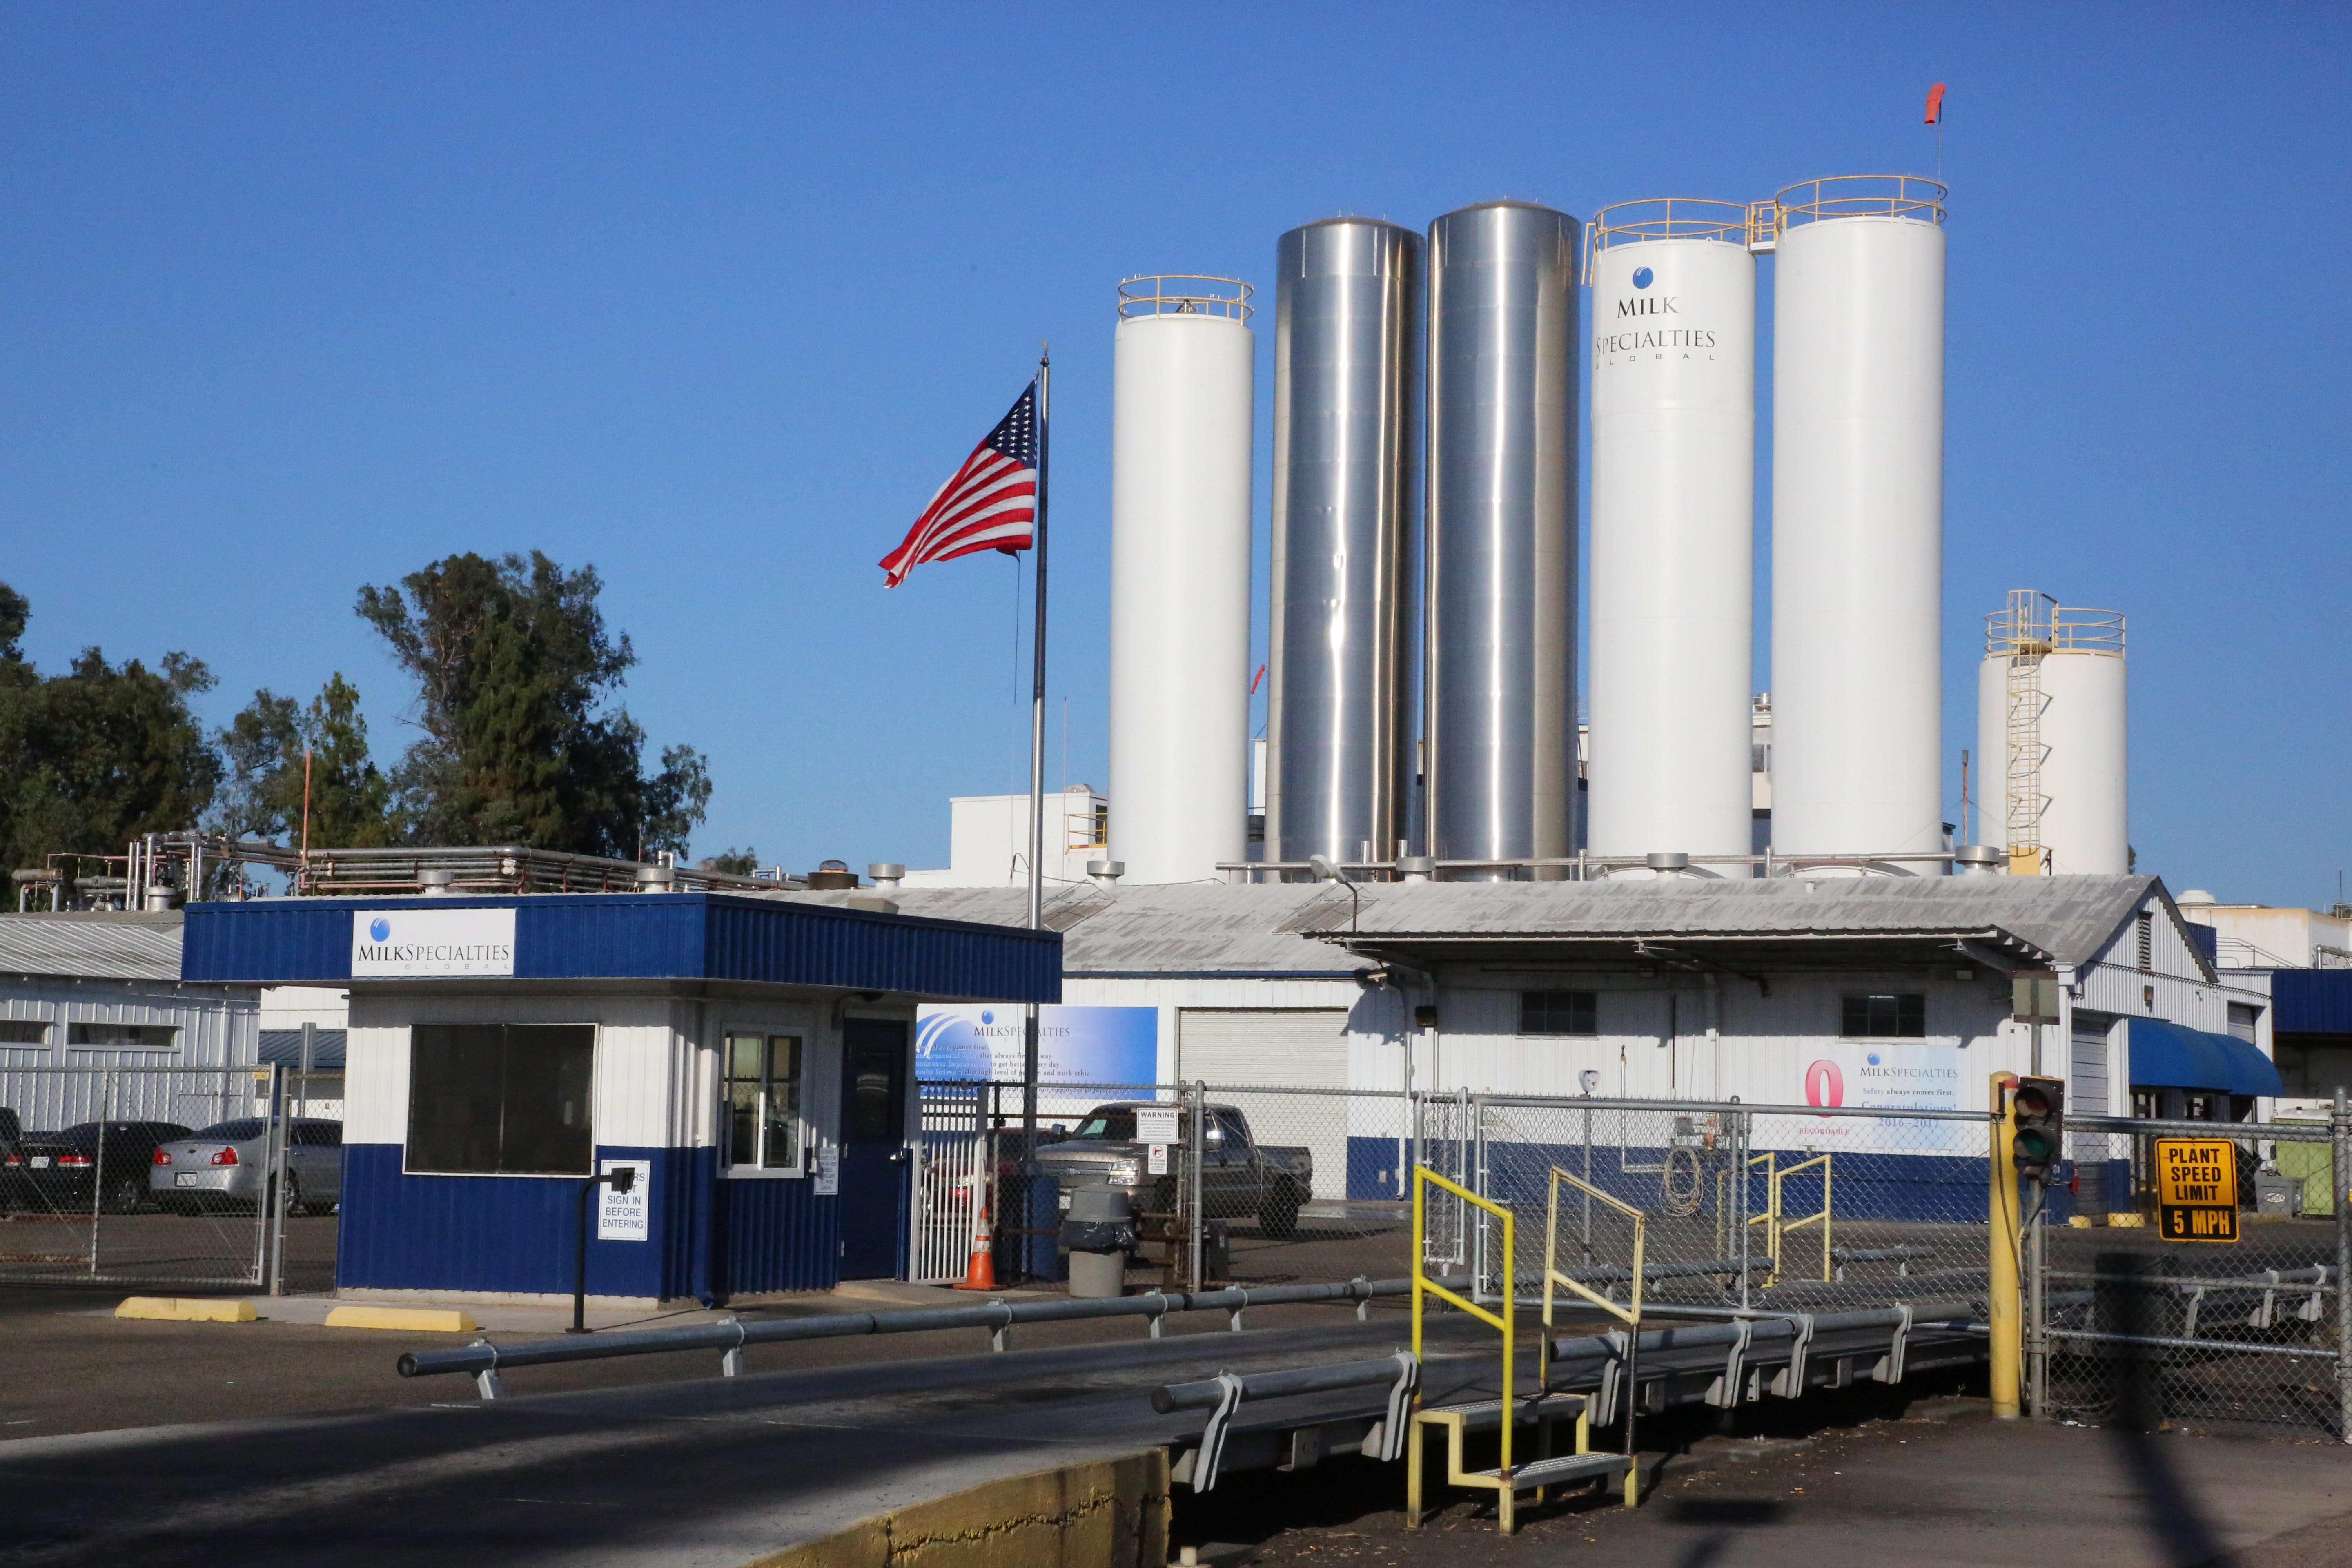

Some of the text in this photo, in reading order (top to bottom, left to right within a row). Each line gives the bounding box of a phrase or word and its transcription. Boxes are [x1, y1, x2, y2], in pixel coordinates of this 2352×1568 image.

[1596, 330, 1715, 357] SPECIALTIES
[1863, 1087, 1884, 1096] Safety
[1886, 1088, 1911, 1096] always
[2169, 1148, 2220, 1164] PLANT
[2171, 1166, 2221, 1182] SPEED
[607, 1195, 641, 1205] SIGN IN
[2175, 1185, 2218, 1200] LIMIT
[606, 1207, 641, 1217] BEFORE
[602, 1219, 644, 1229] ENTERING
[2174, 1210, 2230, 1234] 5 MPH
